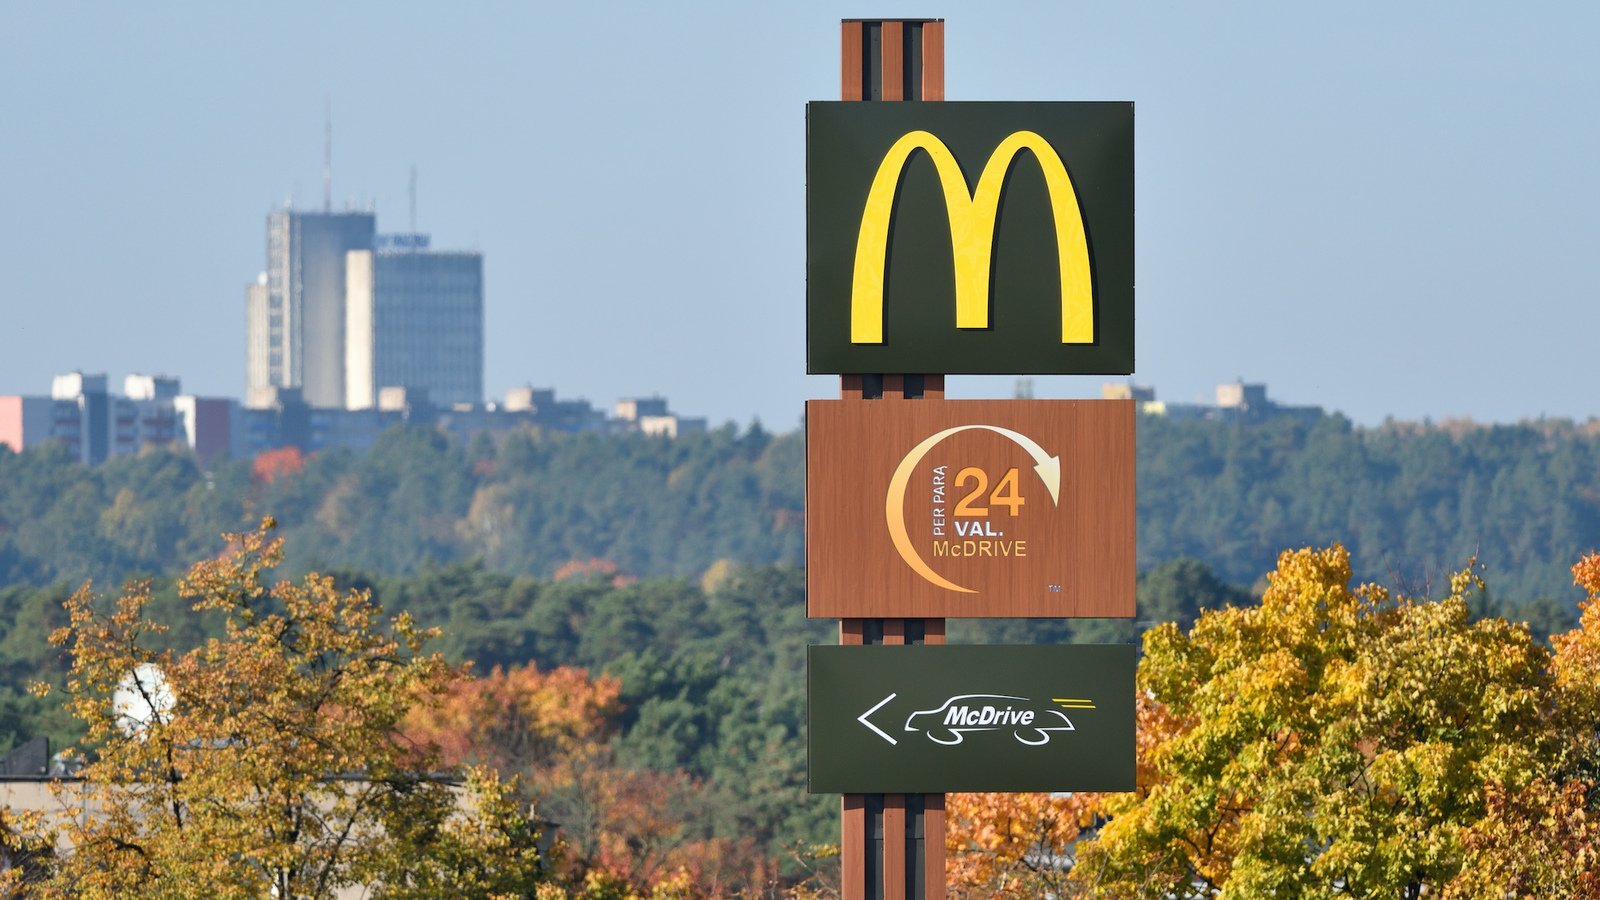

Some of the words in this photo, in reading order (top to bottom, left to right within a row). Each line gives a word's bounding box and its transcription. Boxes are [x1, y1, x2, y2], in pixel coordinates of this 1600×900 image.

[851, 130, 1094, 344] M
[953, 467, 1025, 517] 24
[933, 507, 945, 536] PER
[954, 521, 1003, 537] VAL.
[933, 540, 1027, 557] McDRIVE
[943, 706, 1035, 726] McDrive
